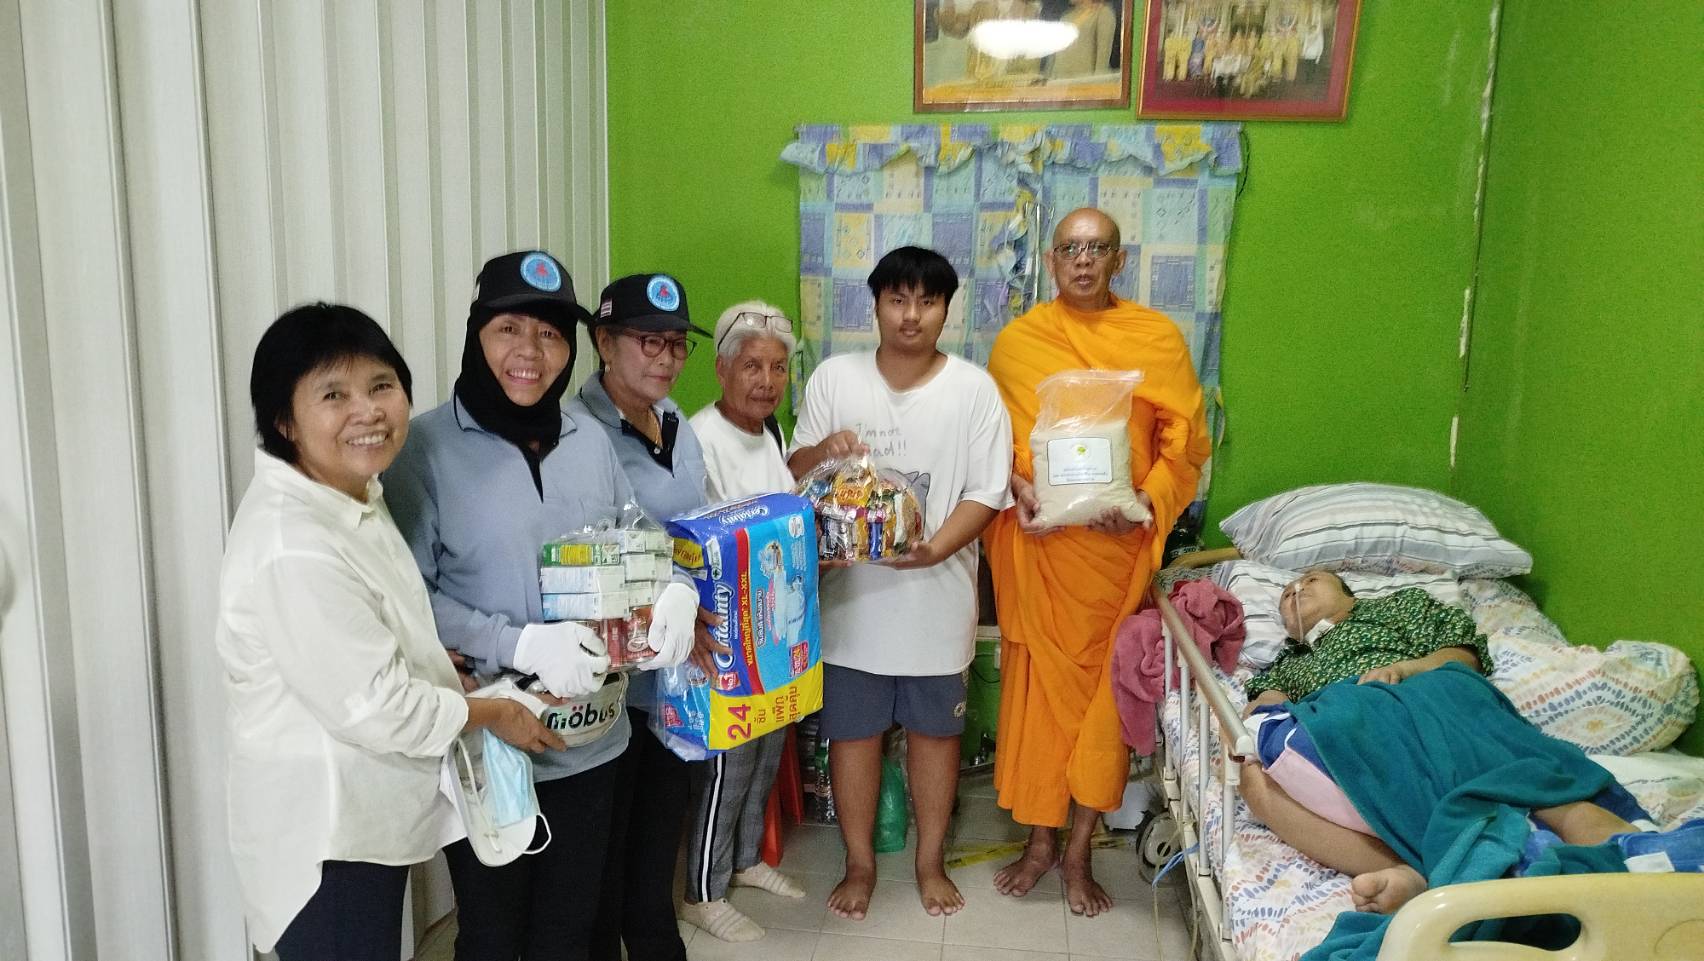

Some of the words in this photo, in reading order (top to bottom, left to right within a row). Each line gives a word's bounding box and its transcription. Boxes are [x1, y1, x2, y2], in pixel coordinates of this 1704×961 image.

[869, 440, 906, 457] ad!!
[739, 573, 749, 605] XL-XXL
[714, 584, 734, 669] Crtainty
[727, 703, 752, 740] 24
